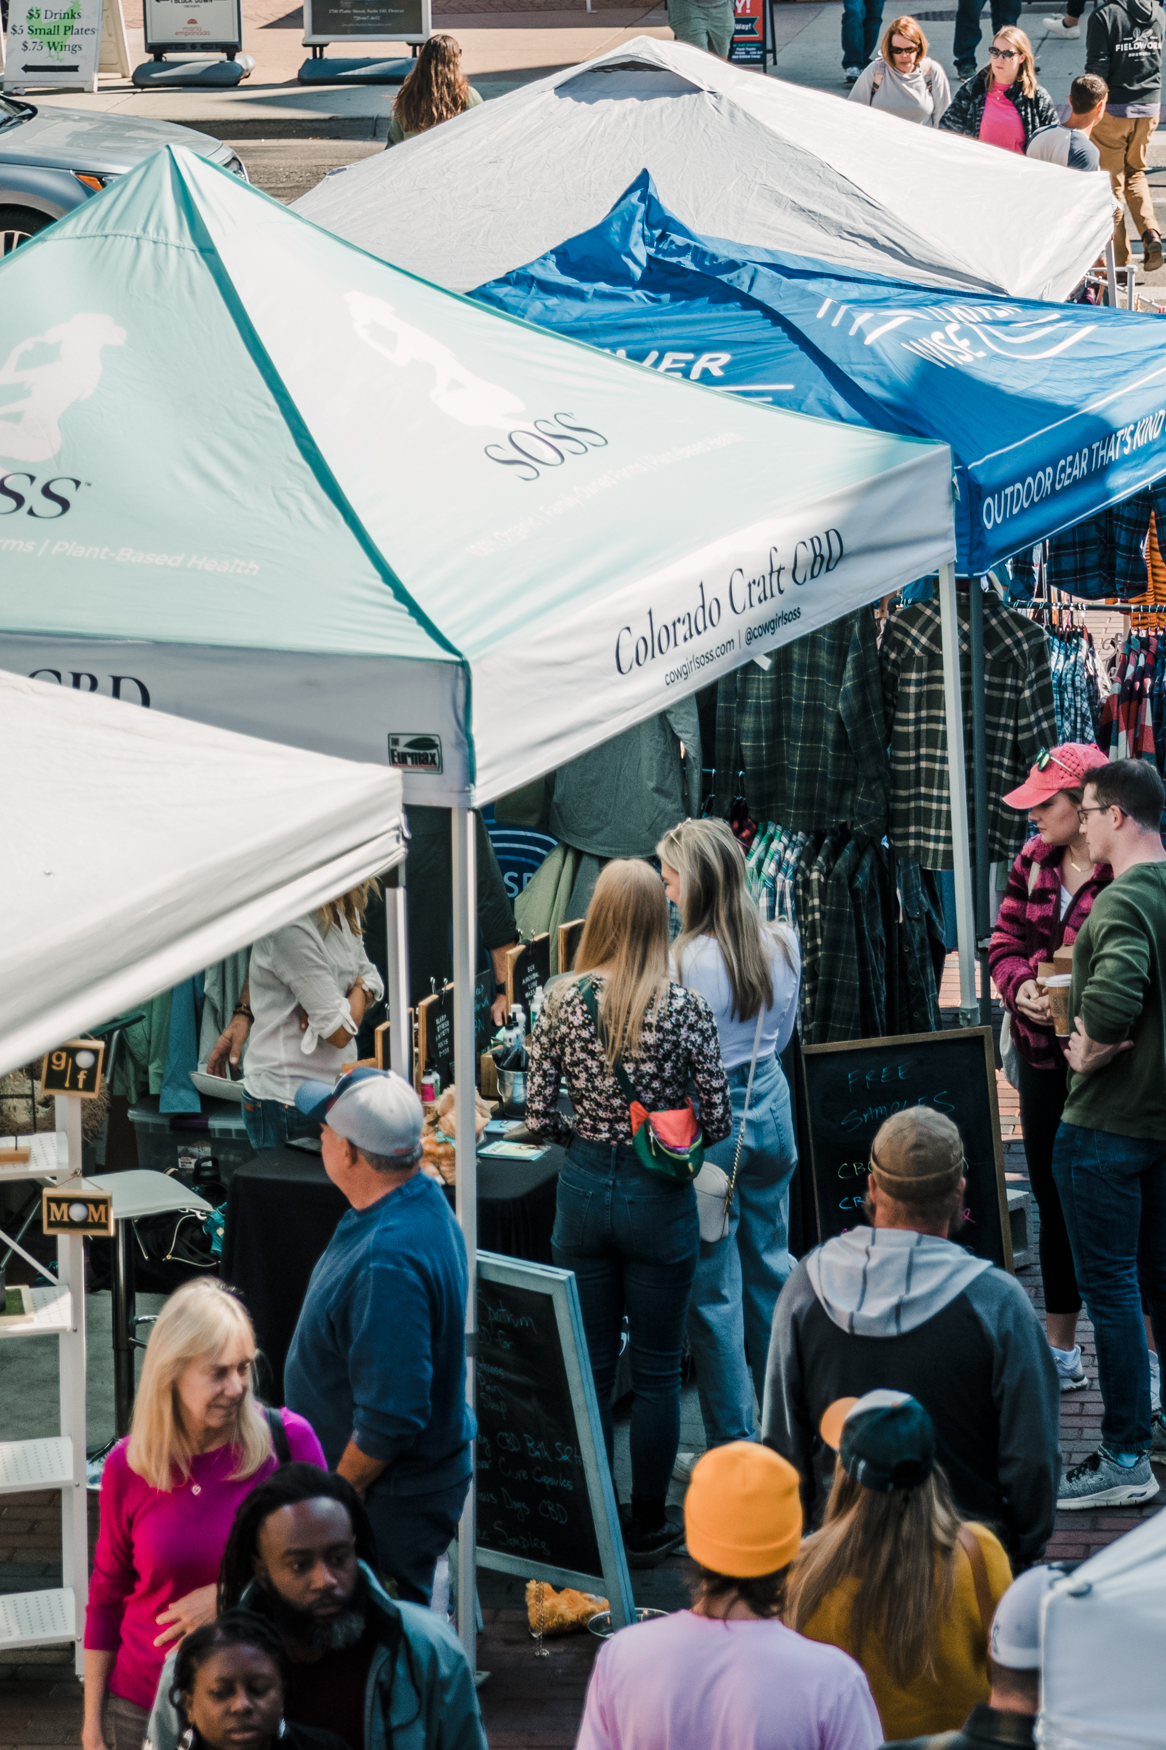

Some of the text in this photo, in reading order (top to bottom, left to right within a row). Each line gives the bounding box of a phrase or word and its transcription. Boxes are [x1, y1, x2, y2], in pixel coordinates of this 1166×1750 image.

[26, 9, 82, 21] $5 Drinks
[735, 0, 750, 13] Y!
[10, 25, 96, 37] $5 Small Plates
[21, 41, 83, 54] $.75 Wings
[484, 412, 608, 481] SOSS
[982, 467, 1053, 530] OUTDOOR
[1055, 447, 1089, 491] GEAR
[1091, 424, 1131, 471] THAT'S
[1133, 408, 1166, 450] KIND
[0, 472, 81, 519] SS
[0, 538, 260, 576] rms Plant-Based Health
[615, 528, 844, 675] Colorado Craft CBD
[664, 606, 801, 685] cowgirlsoss.com @cowgirlsoss
[390, 749, 437, 765] Eurmax
[847, 1064, 912, 1092] FREE
[496, 1432, 521, 1451] CBD
